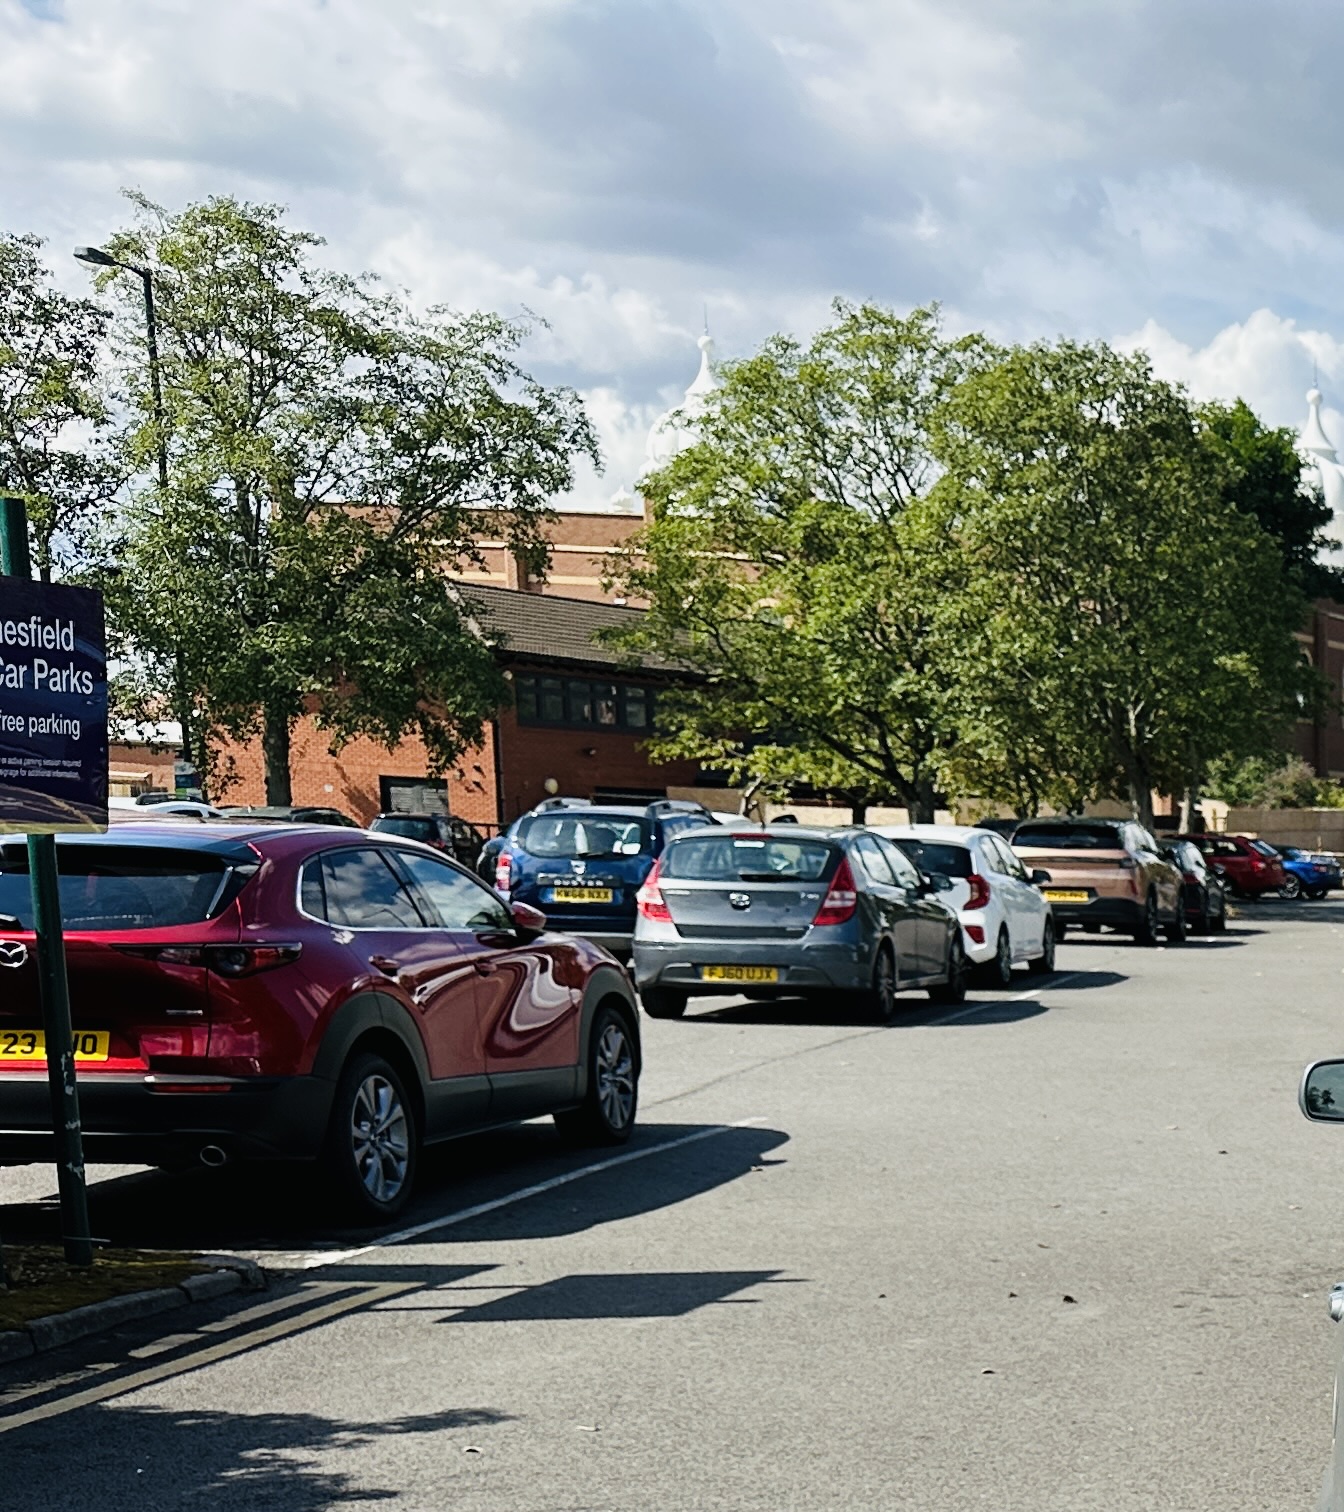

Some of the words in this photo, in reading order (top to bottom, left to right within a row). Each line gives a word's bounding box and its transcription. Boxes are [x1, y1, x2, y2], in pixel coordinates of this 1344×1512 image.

[33, 658, 94, 695] Parks
[28, 712, 80, 741] parking
[0, 1033, 37, 1055] 23
